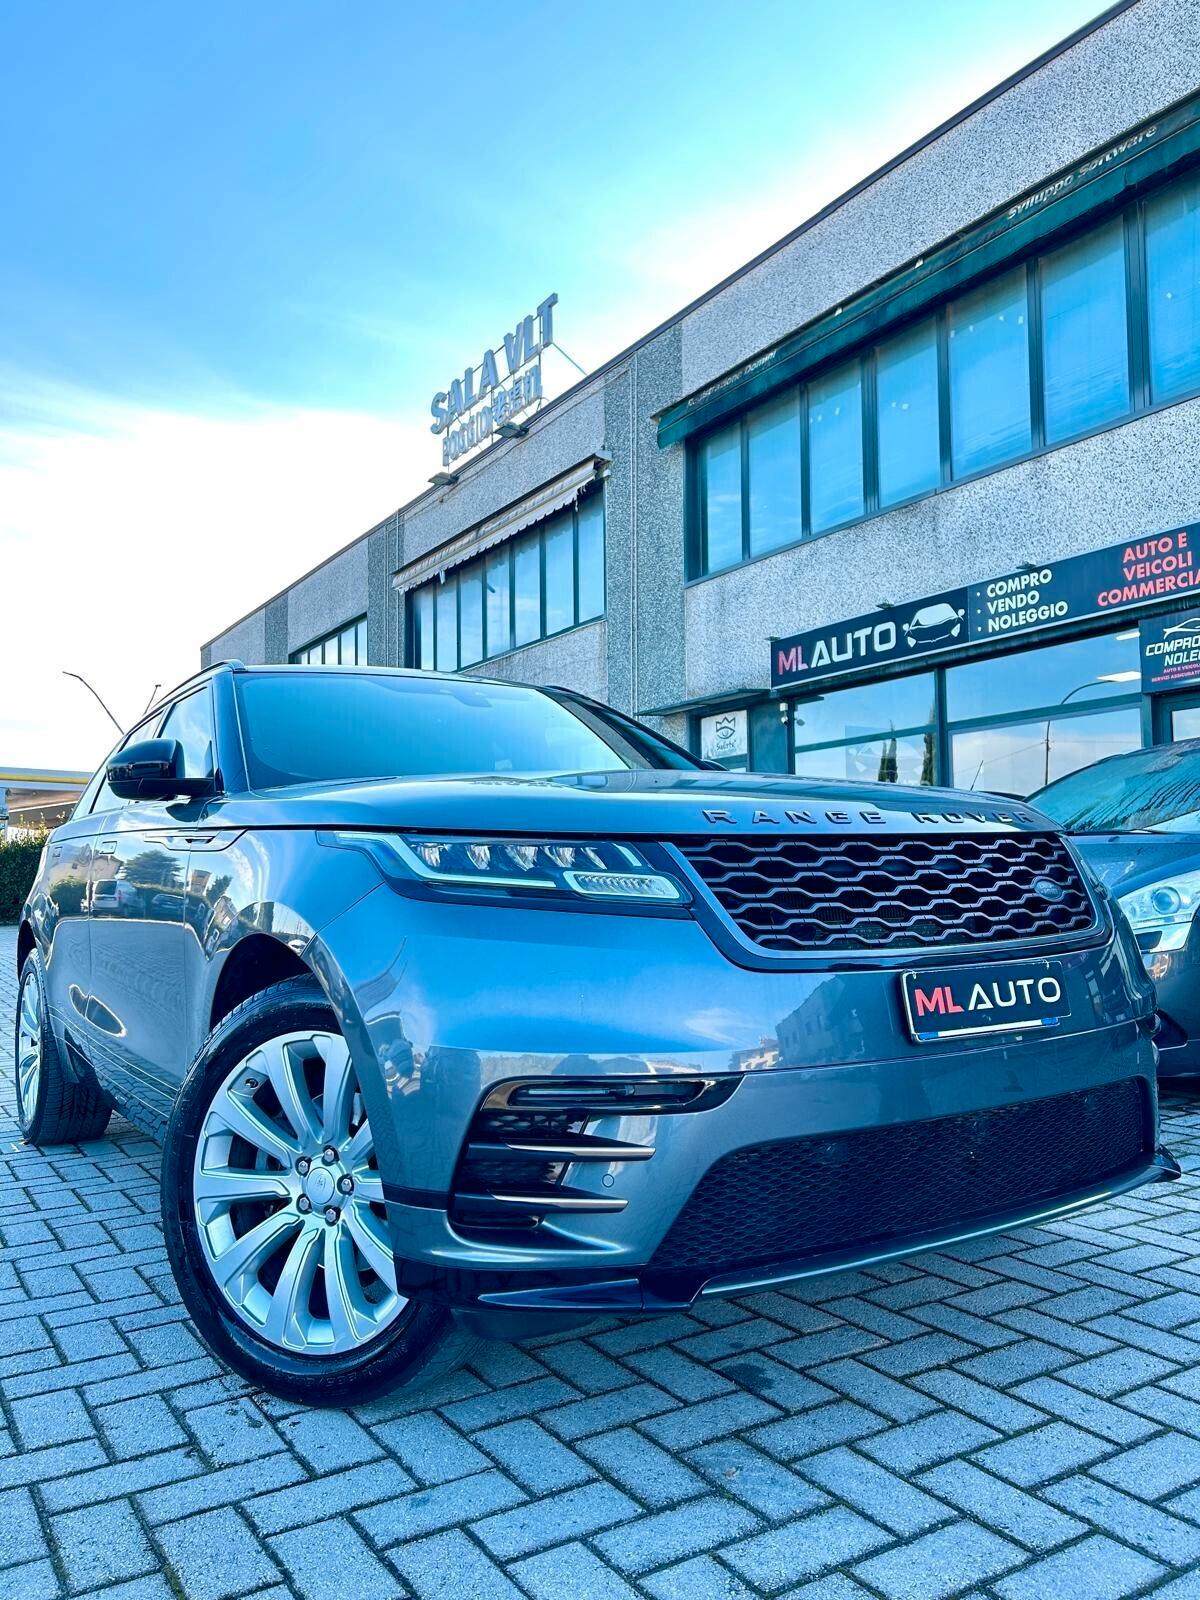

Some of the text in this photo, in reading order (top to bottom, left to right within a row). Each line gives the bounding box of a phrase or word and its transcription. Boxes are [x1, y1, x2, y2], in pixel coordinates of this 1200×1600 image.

[1007, 174, 1074, 220] Sviluppo
[430, 349, 499, 435] SALA
[503, 292, 558, 375] VLT
[1122, 532, 1188, 564] AUTO E
[1122, 551, 1193, 581] VEICOLI
[986, 569, 1052, 598] COMPRO
[987, 590, 1040, 615] VENDO
[988, 601, 1068, 633] NOLEGGIO
[810, 621, 897, 668] AUTO
[1145, 635, 1200, 657] COMPRO
[1164, 649, 1200, 667] NOLE
[702, 808, 1036, 825] RANGE ROVER
[914, 977, 1062, 1017] ML AUTO
